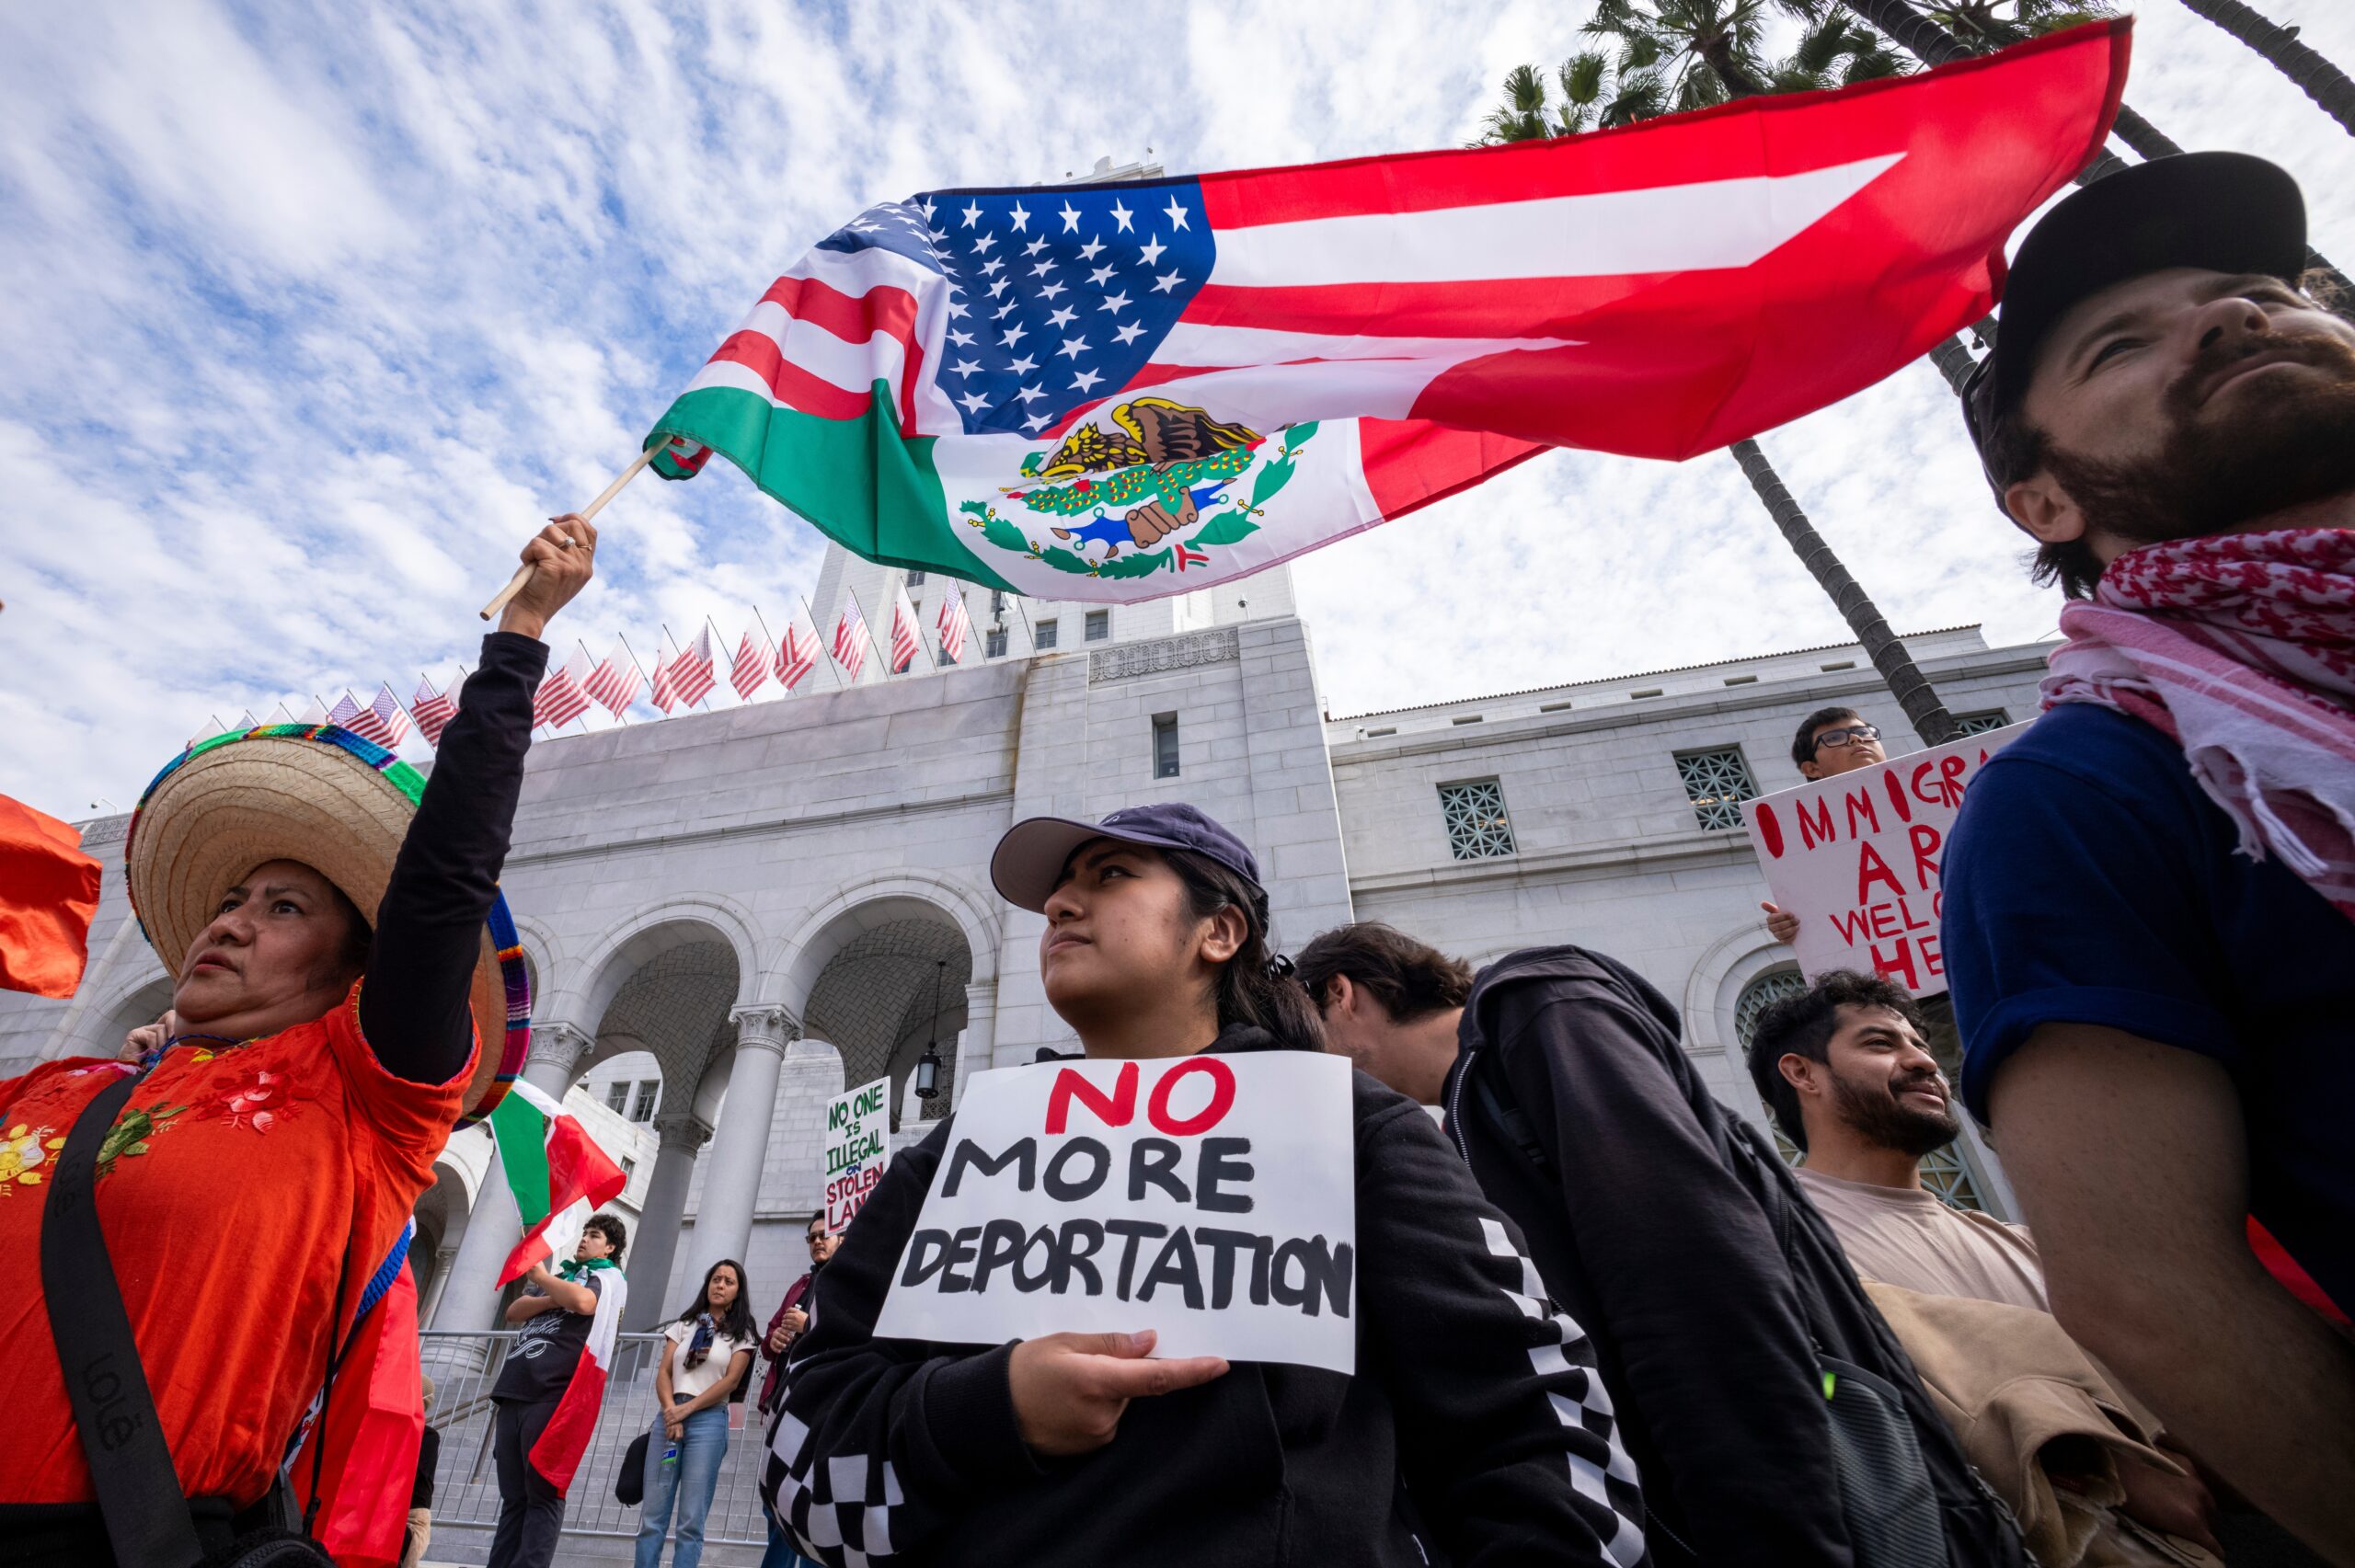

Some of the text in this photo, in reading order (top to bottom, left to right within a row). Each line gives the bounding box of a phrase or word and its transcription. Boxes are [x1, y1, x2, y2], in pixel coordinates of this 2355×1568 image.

[1756, 749, 1989, 859] IMMIGR
[1858, 824, 1941, 906] AR
[1869, 934, 1943, 990] HE
[829, 1083, 884, 1132] NO ONE
[1045, 1057, 1236, 1136] NO
[826, 1128, 885, 1176] ILLEGAL
[845, 1121, 860, 1139] IS
[826, 1161, 884, 1205] STOLEN
[846, 1162, 861, 1176] ON
[940, 1136, 1255, 1213] MORE
[828, 1192, 867, 1231] LAN
[901, 1219, 1354, 1319] DEPORTATION
